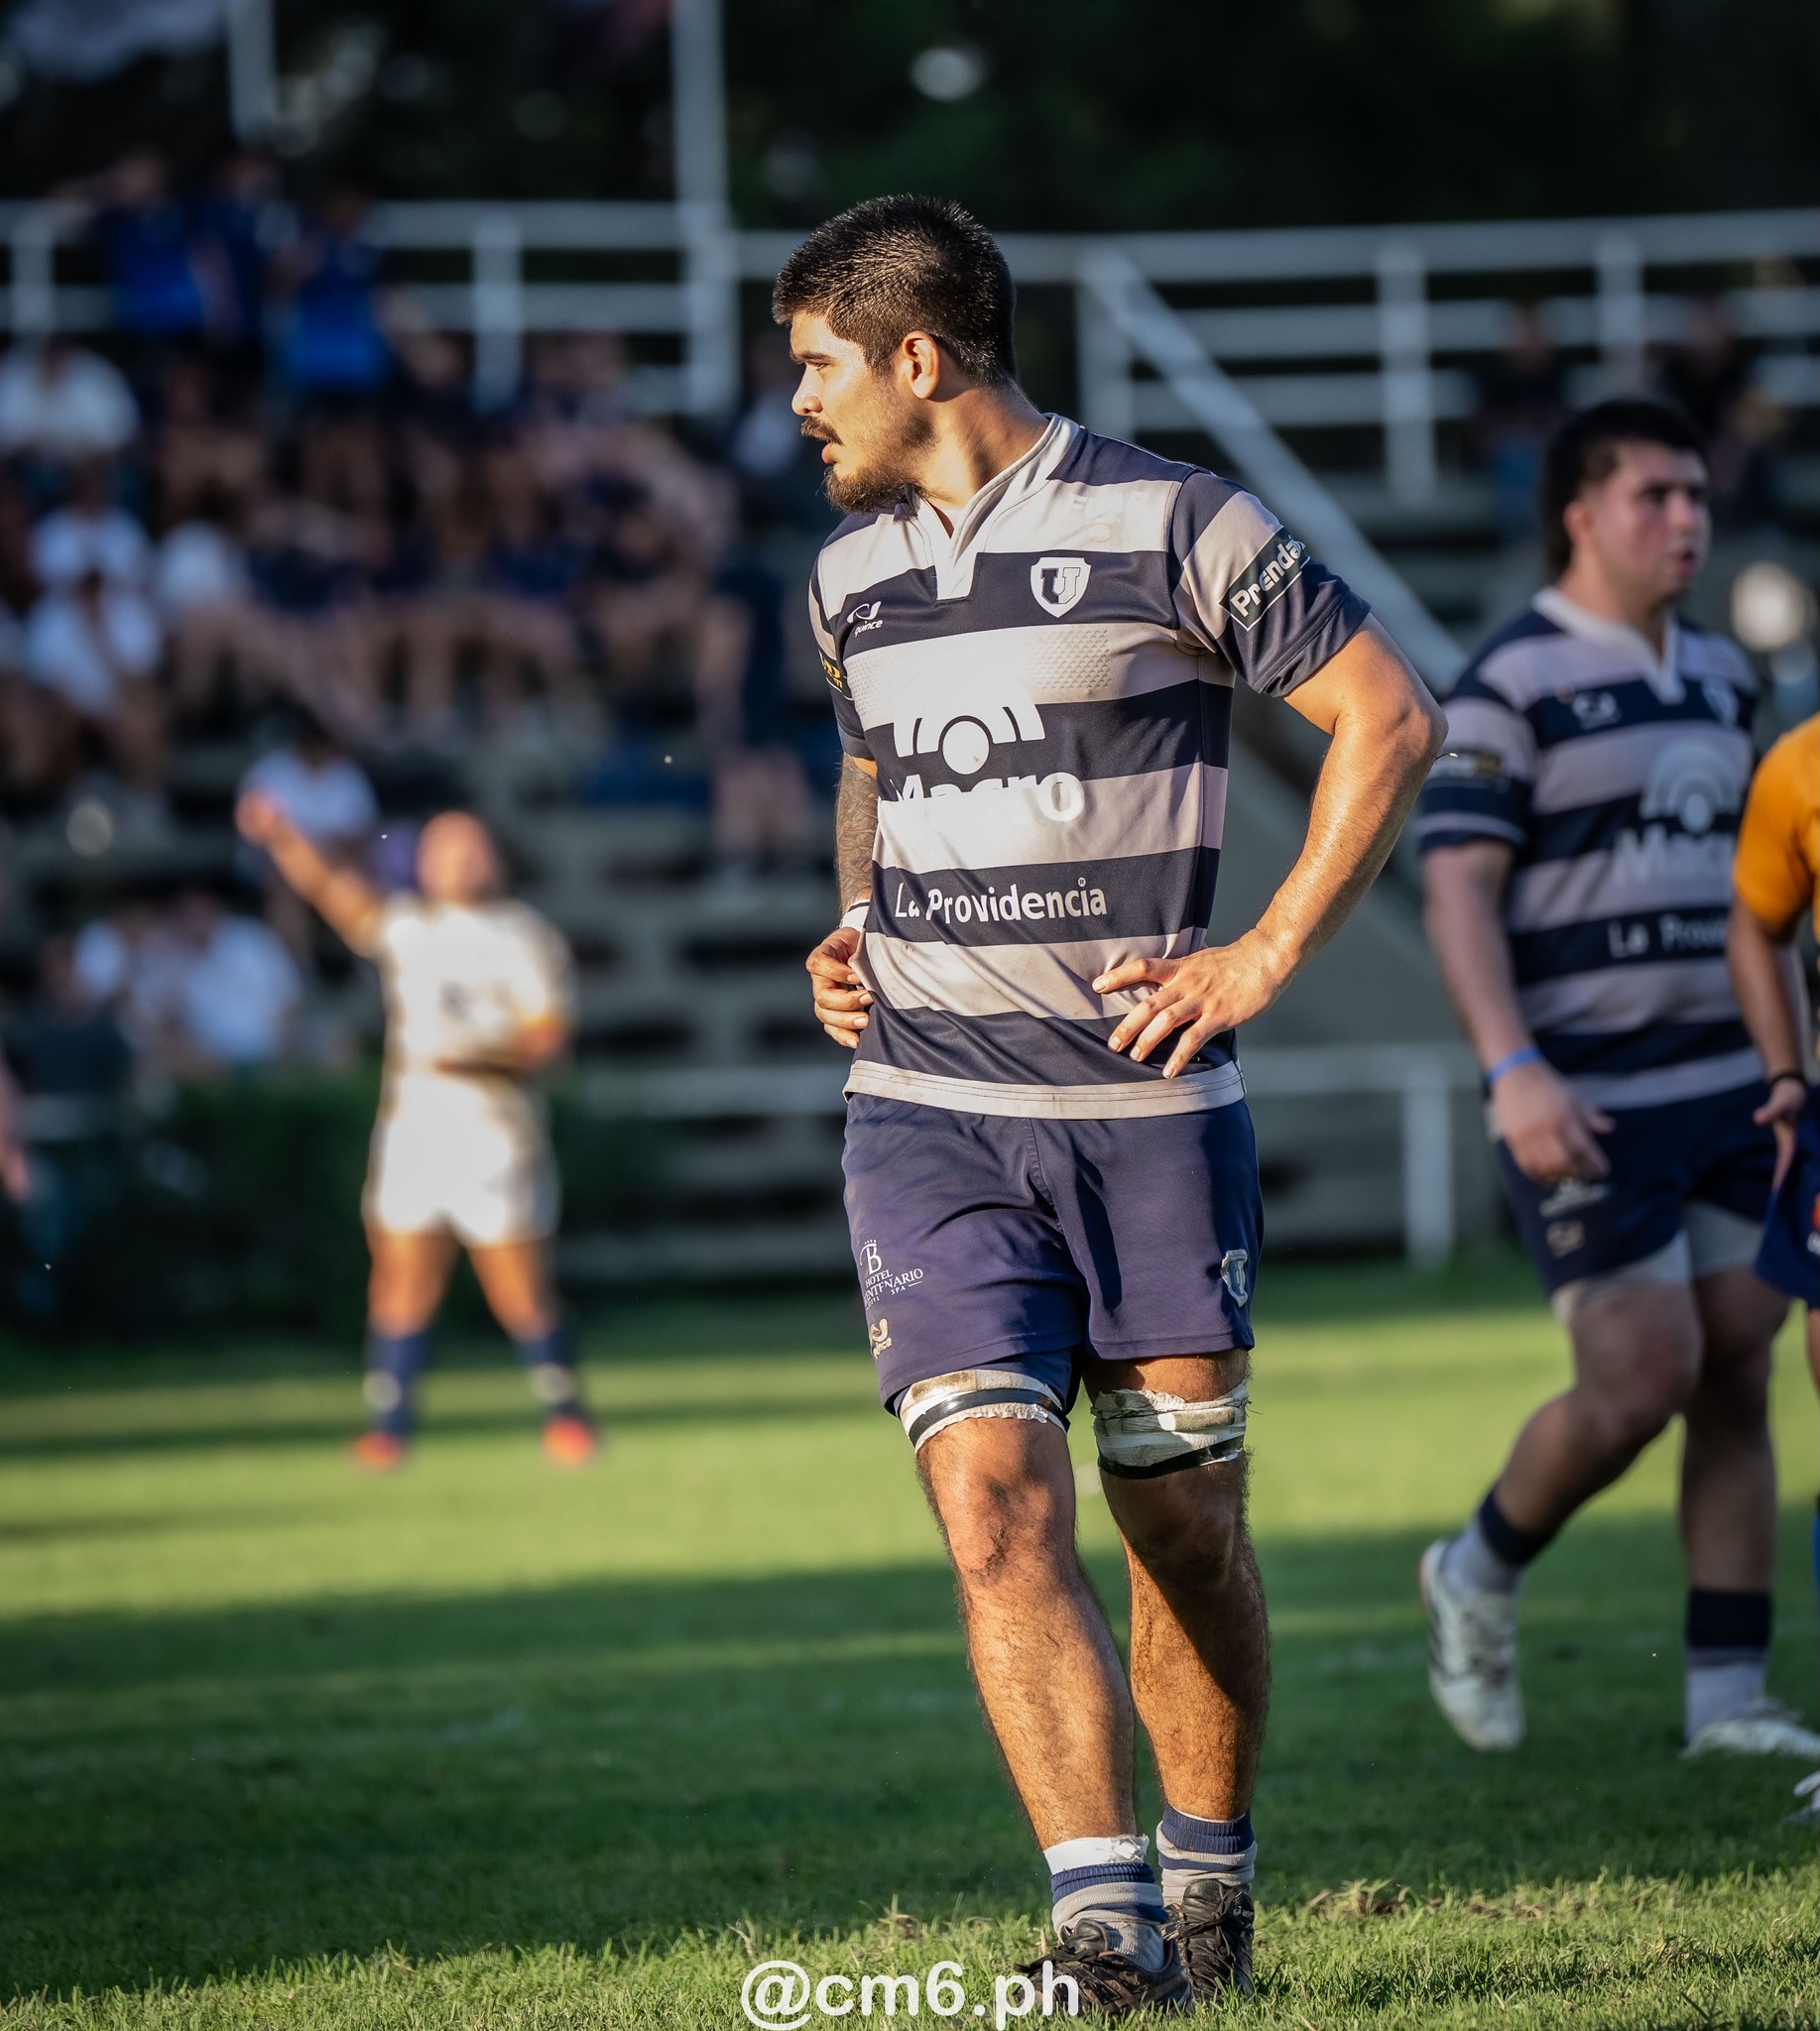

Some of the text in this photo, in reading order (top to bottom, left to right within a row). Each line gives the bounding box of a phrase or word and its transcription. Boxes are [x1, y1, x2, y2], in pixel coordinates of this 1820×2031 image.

[895, 883, 1107, 924] La Providencia
[865, 1269, 893, 1288] HOTEL
